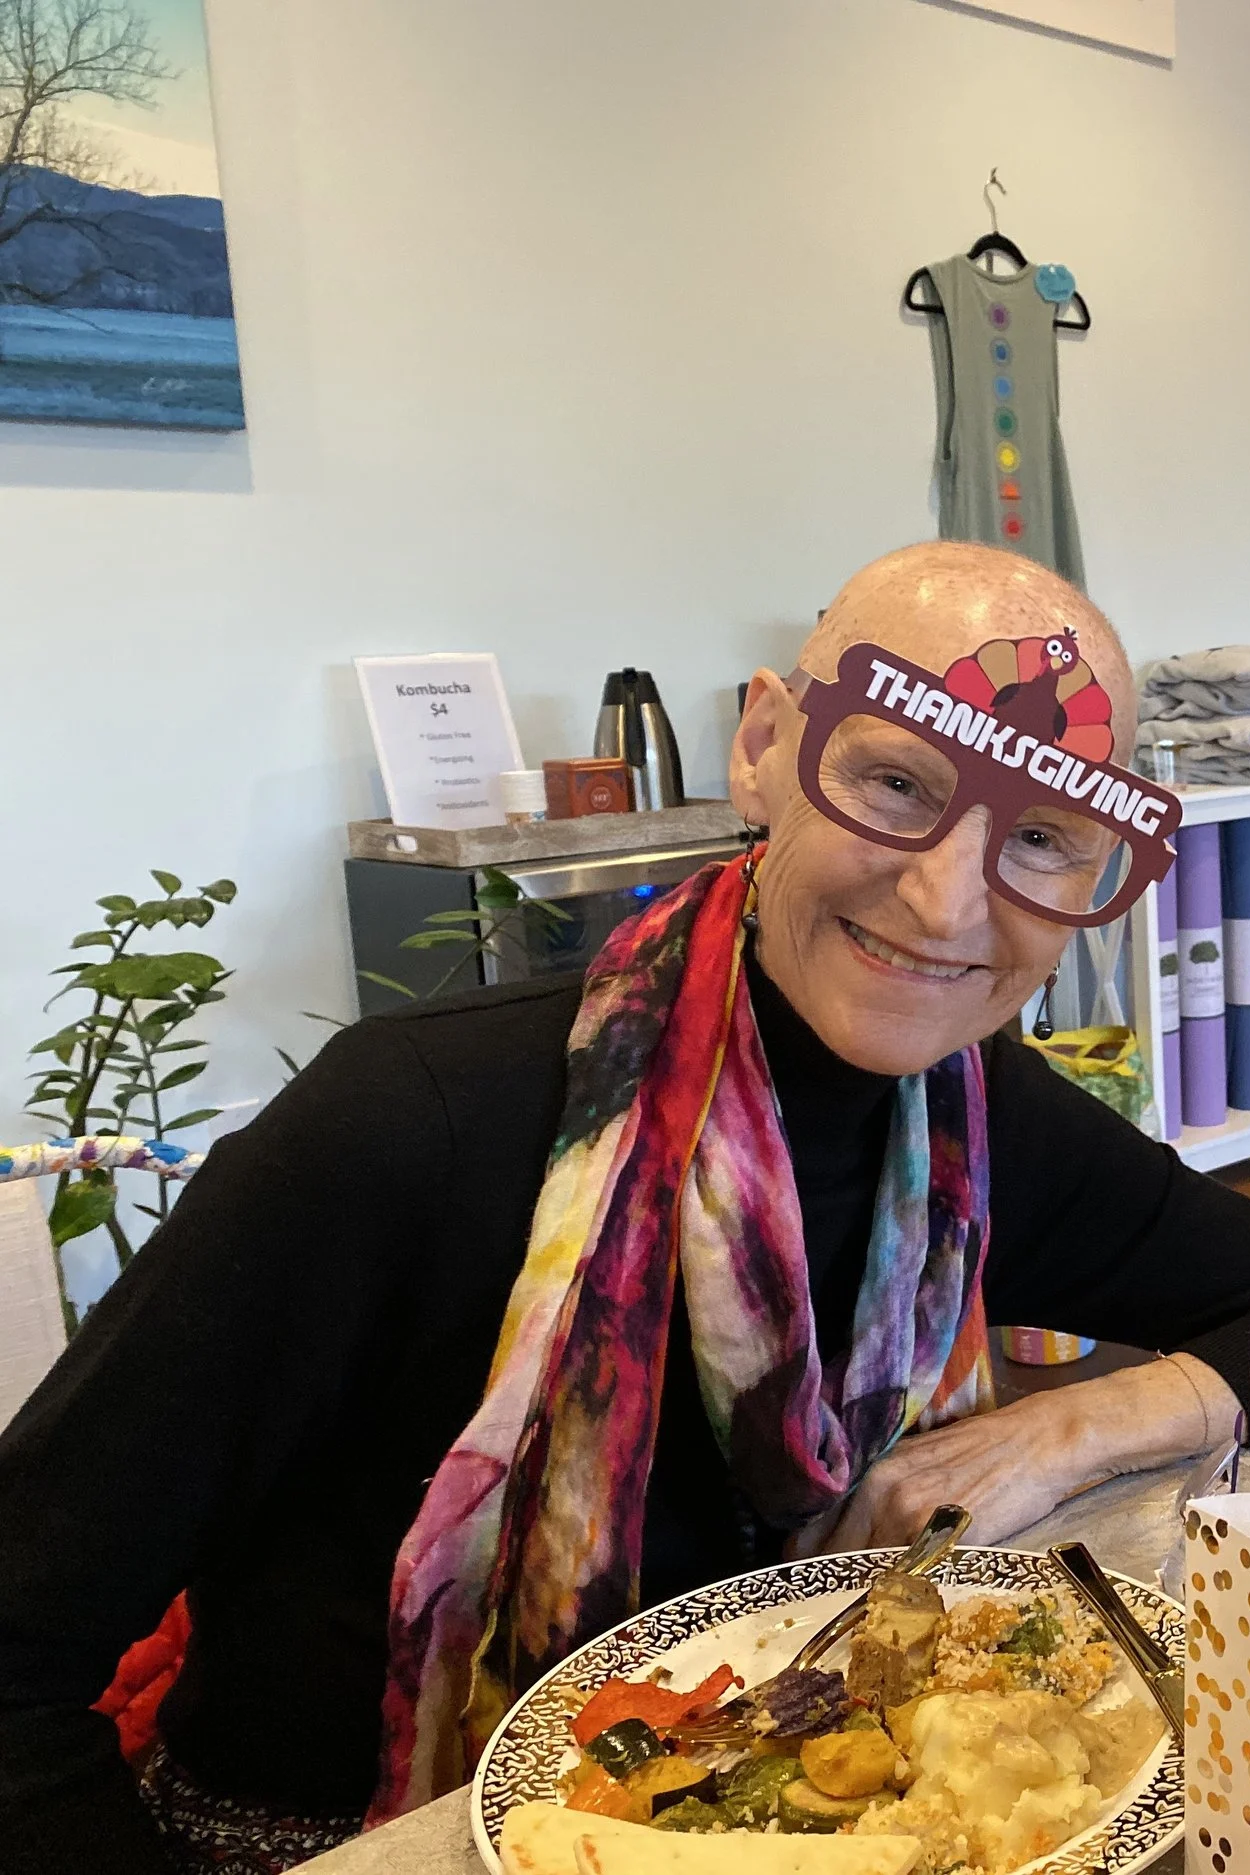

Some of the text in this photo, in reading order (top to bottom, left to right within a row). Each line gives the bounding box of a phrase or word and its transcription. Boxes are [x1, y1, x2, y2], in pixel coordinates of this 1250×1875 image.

[395, 681, 471, 697] Kombucha
[430, 702, 448, 718] $4
[864, 659, 1169, 836] THANKSGIVING
